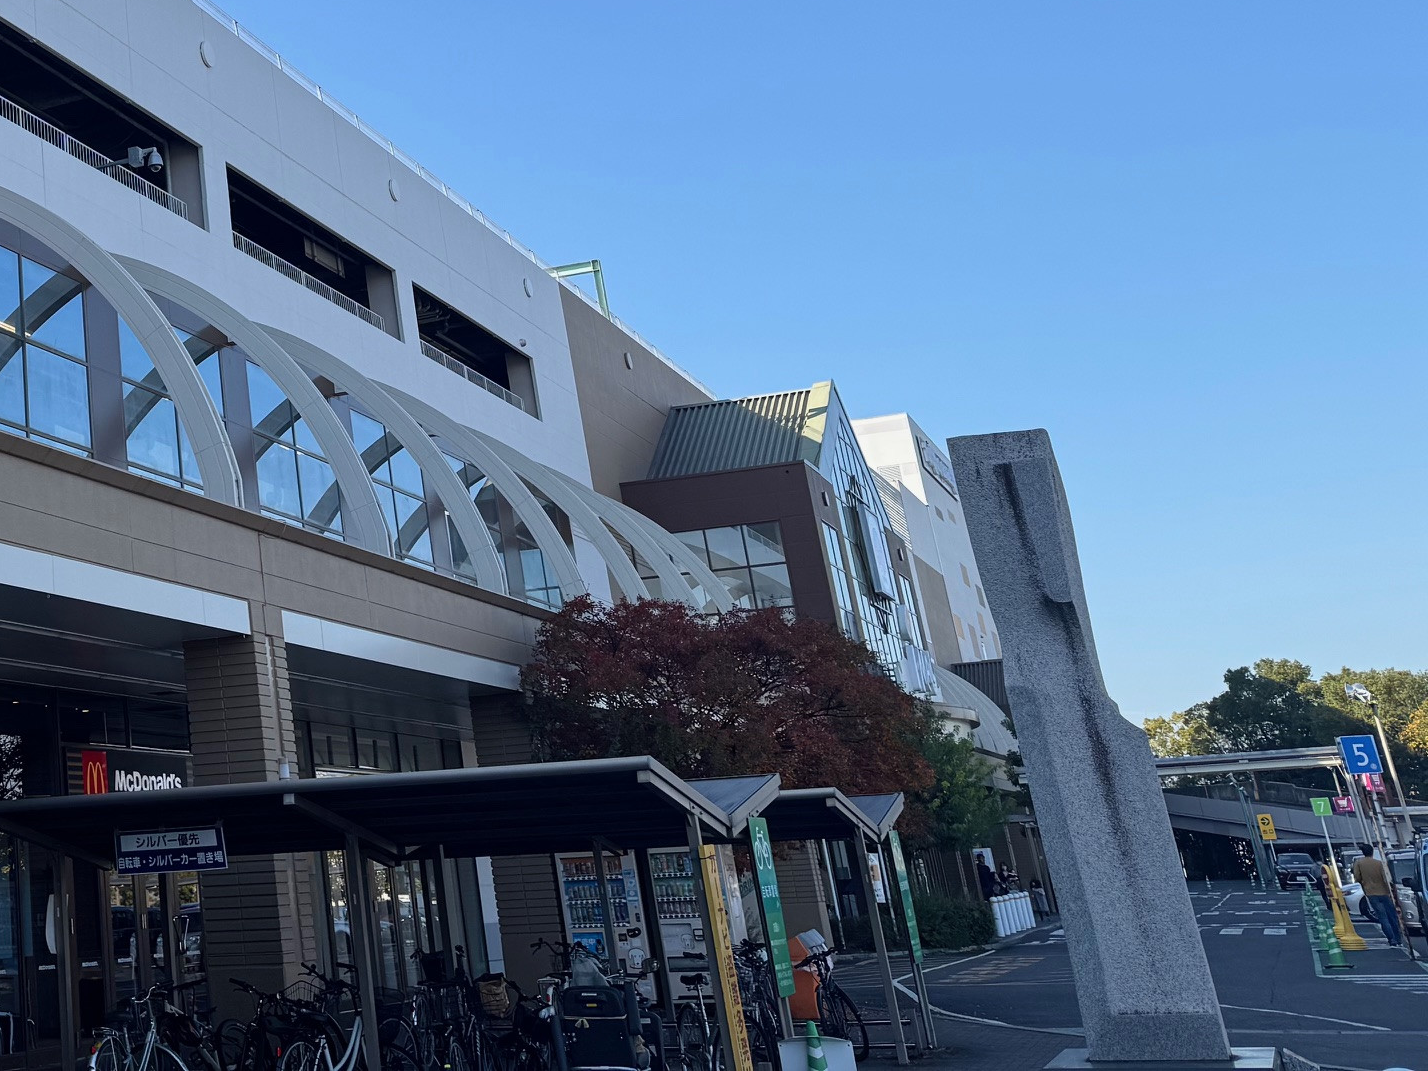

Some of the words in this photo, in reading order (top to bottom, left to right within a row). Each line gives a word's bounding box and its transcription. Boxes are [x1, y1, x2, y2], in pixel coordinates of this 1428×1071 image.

[1352, 743, 1369, 767] 5
[114, 769, 182, 791] McDonald's
[1316, 801, 1325, 812] 7
[135, 833, 200, 848] シルバー優先
